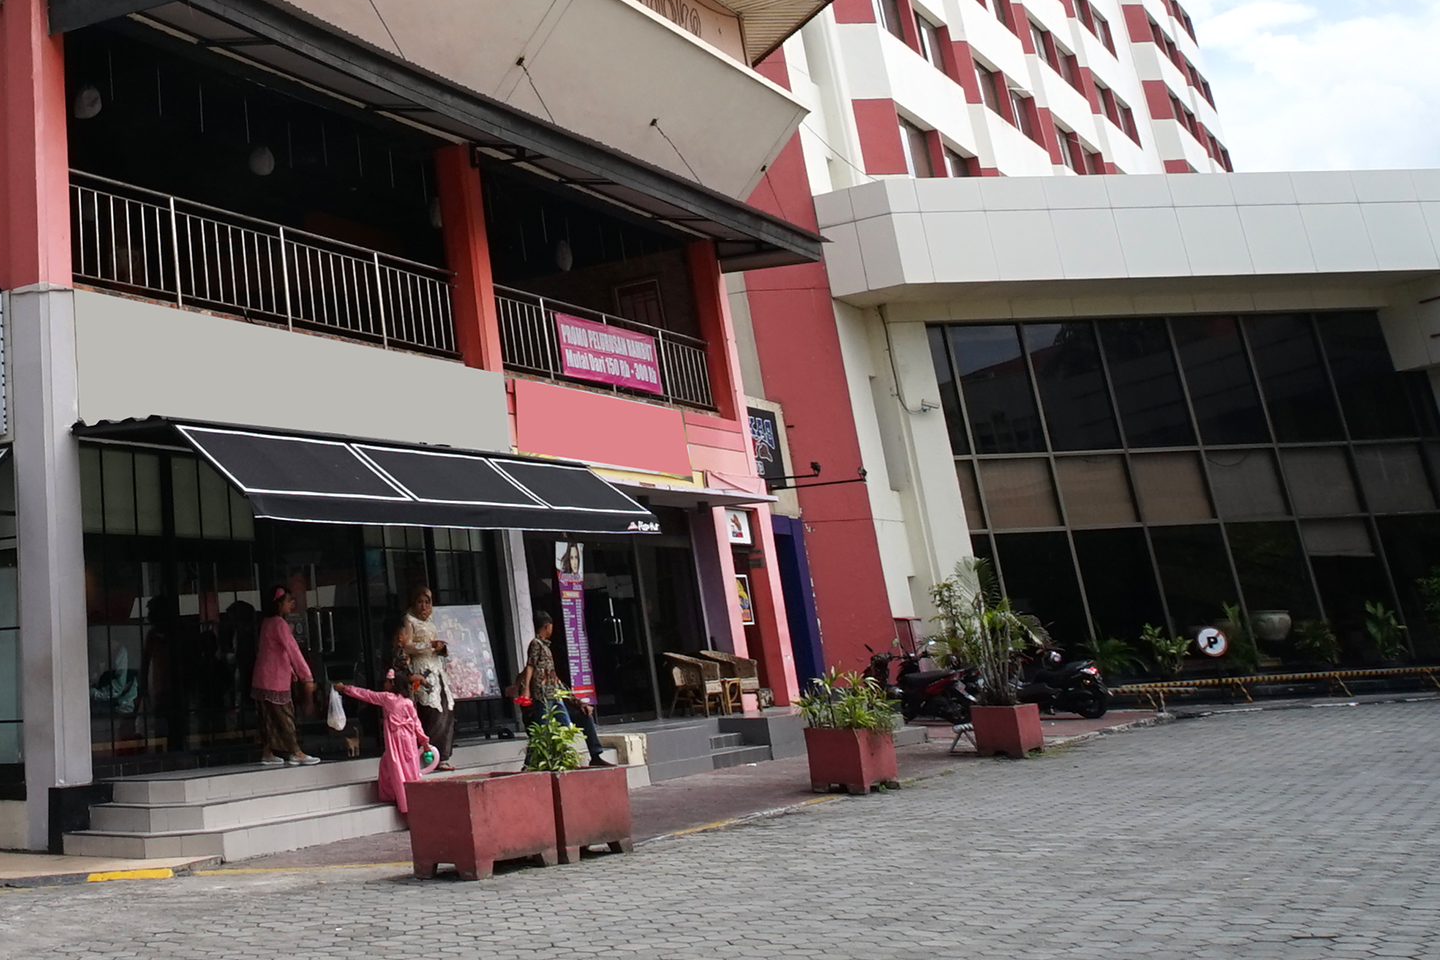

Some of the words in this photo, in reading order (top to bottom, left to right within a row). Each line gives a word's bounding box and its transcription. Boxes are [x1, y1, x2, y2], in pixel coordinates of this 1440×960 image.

[560, 323, 588, 347] PROMO
[565, 348, 589, 370] Mulai
[589, 353, 606, 374] Dari
[605, 356, 619, 377] 150
